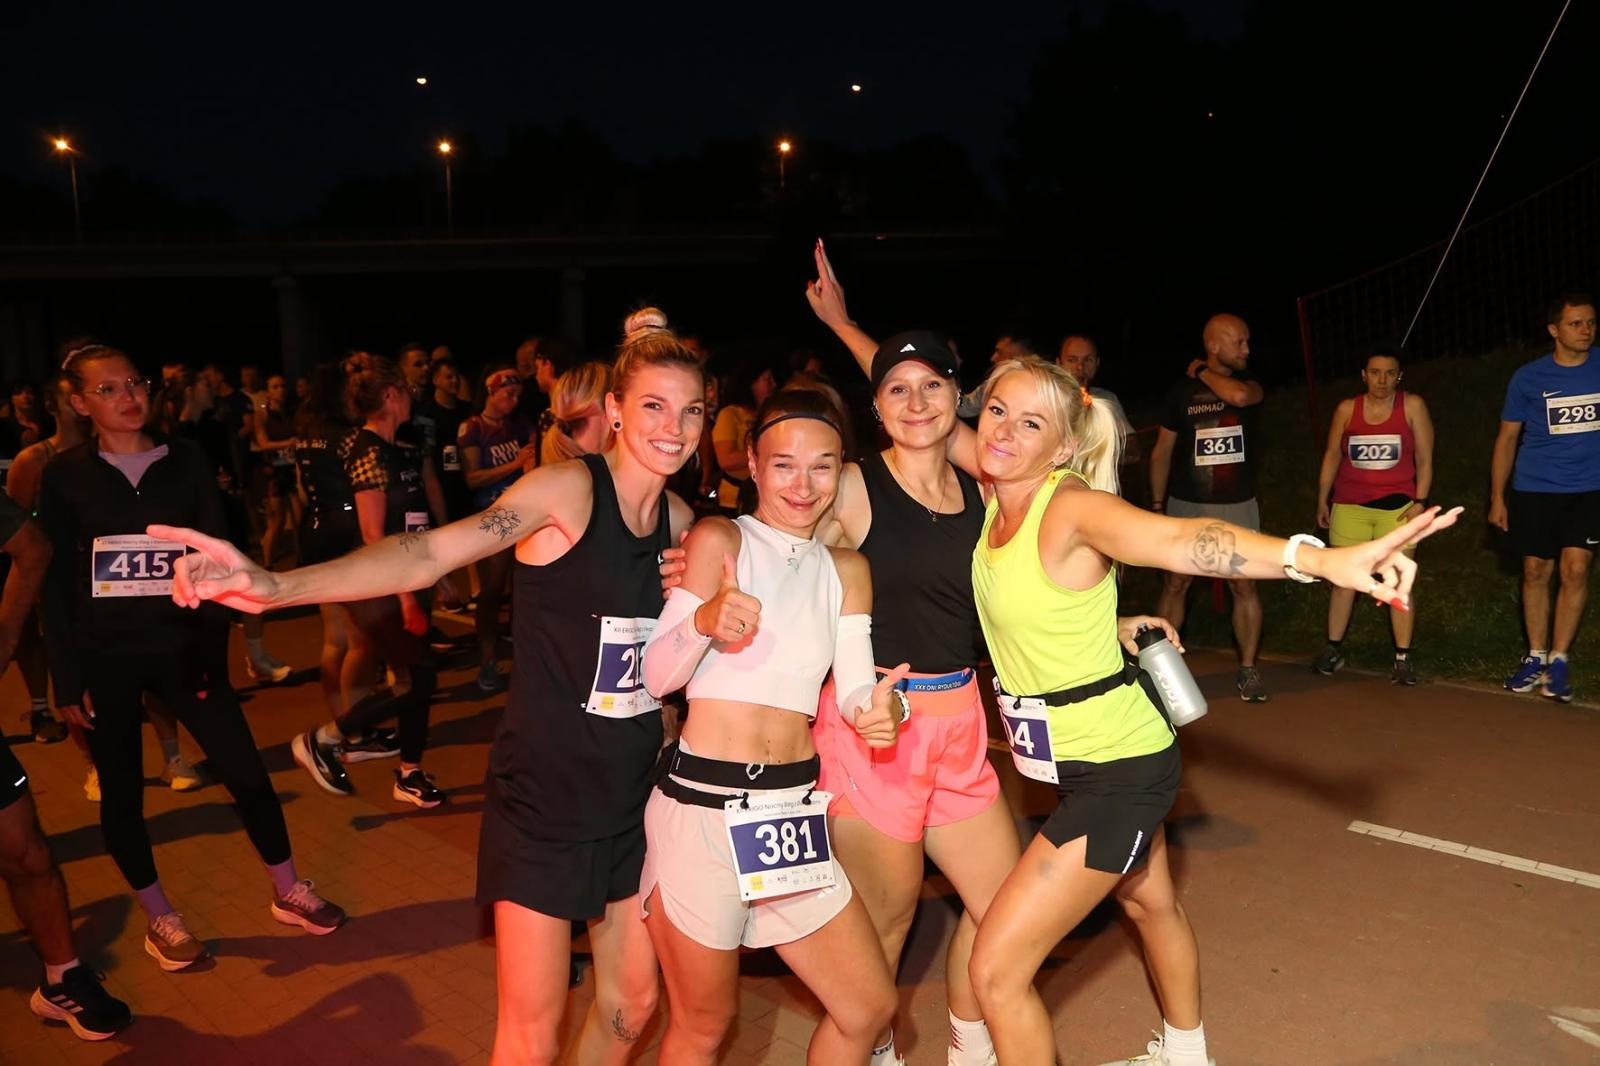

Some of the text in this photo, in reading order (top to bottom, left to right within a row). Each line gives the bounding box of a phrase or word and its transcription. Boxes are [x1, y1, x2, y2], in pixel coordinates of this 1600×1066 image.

[1187, 402, 1225, 415] RUNMAG
[1558, 405, 1597, 423] 298
[1203, 437, 1236, 454] 361
[1357, 445, 1392, 460] 202
[109, 552, 169, 578] 415
[755, 819, 818, 866] 381
